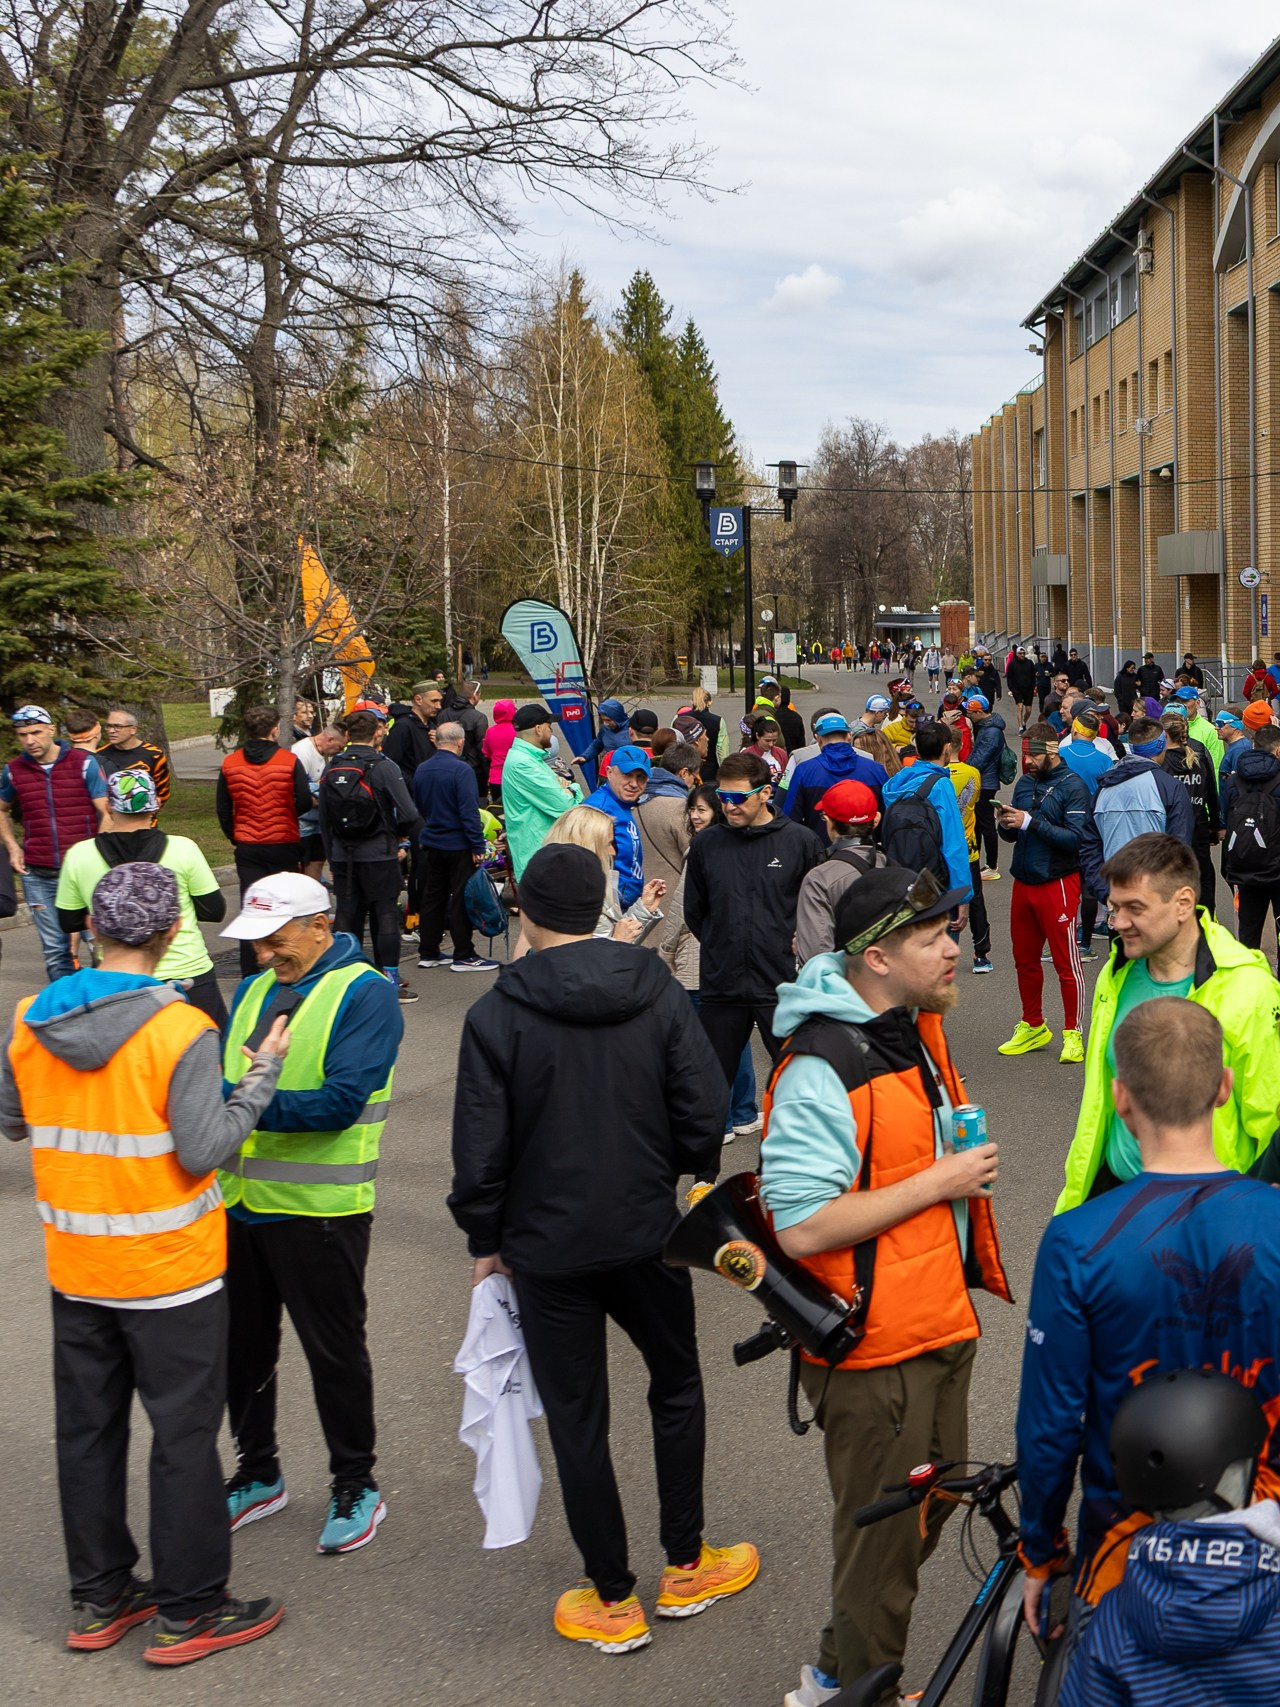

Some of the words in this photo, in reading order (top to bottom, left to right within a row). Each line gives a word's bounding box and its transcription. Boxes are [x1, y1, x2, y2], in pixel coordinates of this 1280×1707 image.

[714, 538, 739, 546] СТАРТ
[1178, 1539, 1199, 1564] N
[1205, 1540, 1244, 1566] 22
